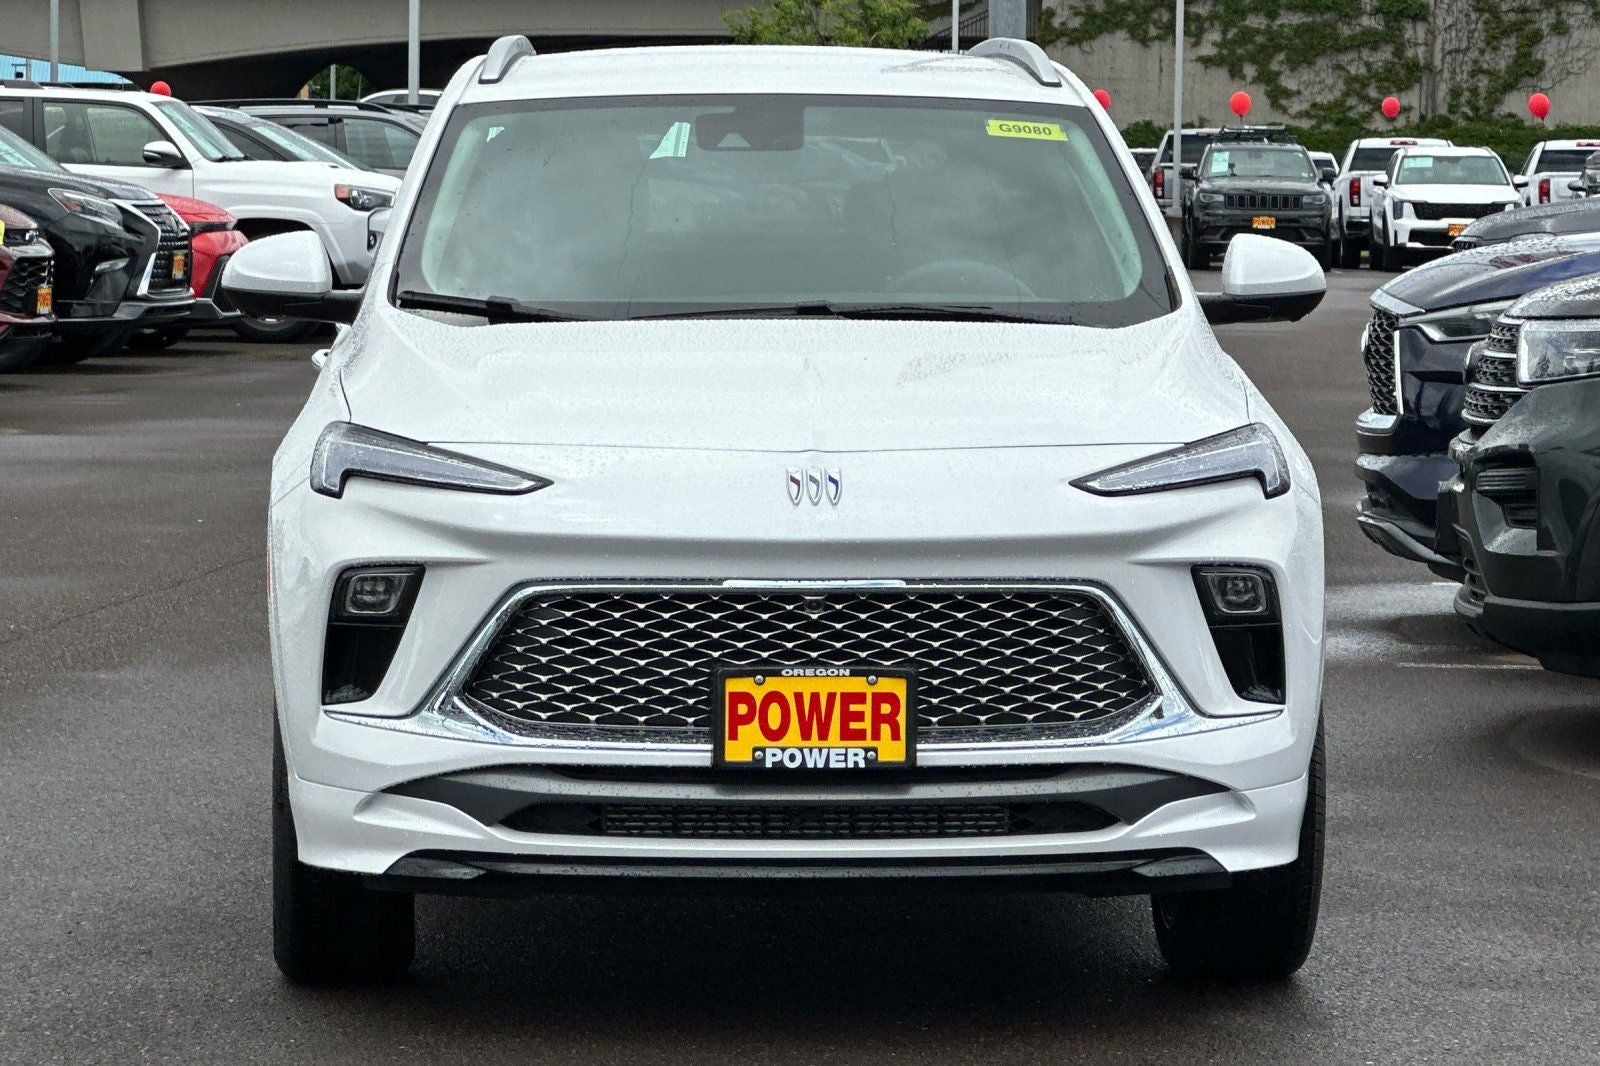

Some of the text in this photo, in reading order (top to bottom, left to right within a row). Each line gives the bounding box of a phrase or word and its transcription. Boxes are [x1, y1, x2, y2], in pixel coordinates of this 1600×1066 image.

[999, 123, 1052, 136] G9080
[781, 668, 850, 677] OREGON
[728, 691, 901, 742] POWER
[765, 748, 865, 769] POWER
